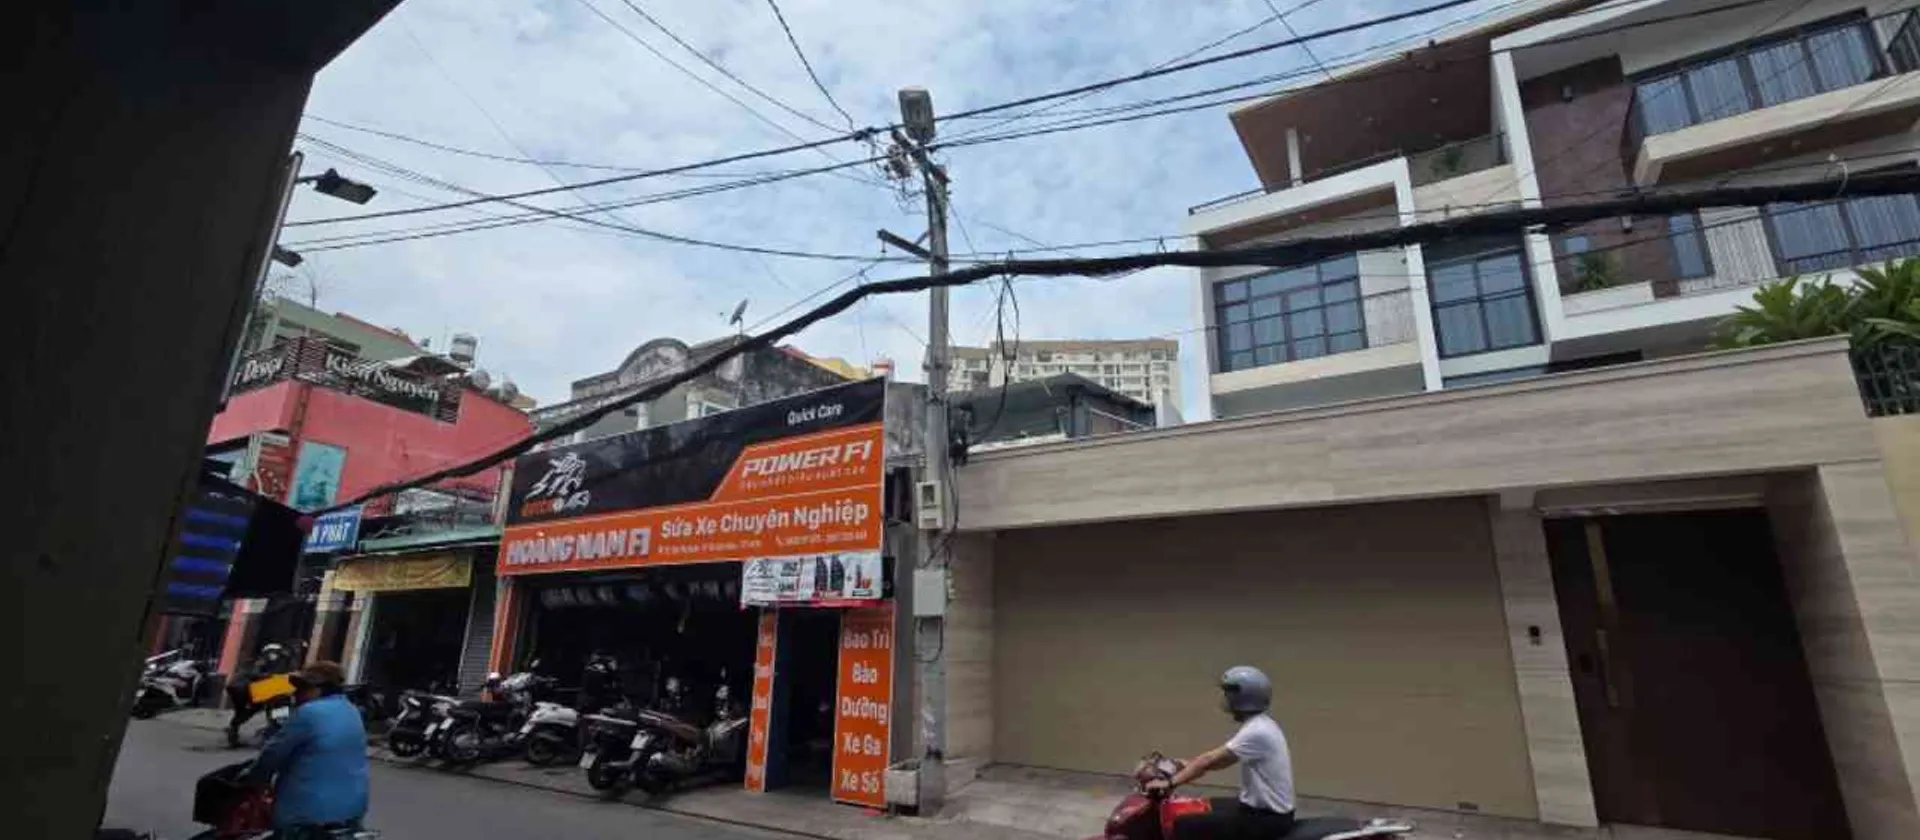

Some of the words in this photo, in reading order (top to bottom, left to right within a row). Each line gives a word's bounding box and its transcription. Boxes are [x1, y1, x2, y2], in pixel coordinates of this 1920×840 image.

[787, 407, 816, 426] Quick
[818, 403, 844, 418] Care
[742, 444, 842, 479] POWER
[696, 516, 717, 535] Xe
[720, 507, 789, 535] Chuyên
[794, 499, 870, 529] Nghiệp
[576, 529, 627, 560] NAM
[842, 732, 861, 755] Xe
[841, 768, 857, 792] Xe
